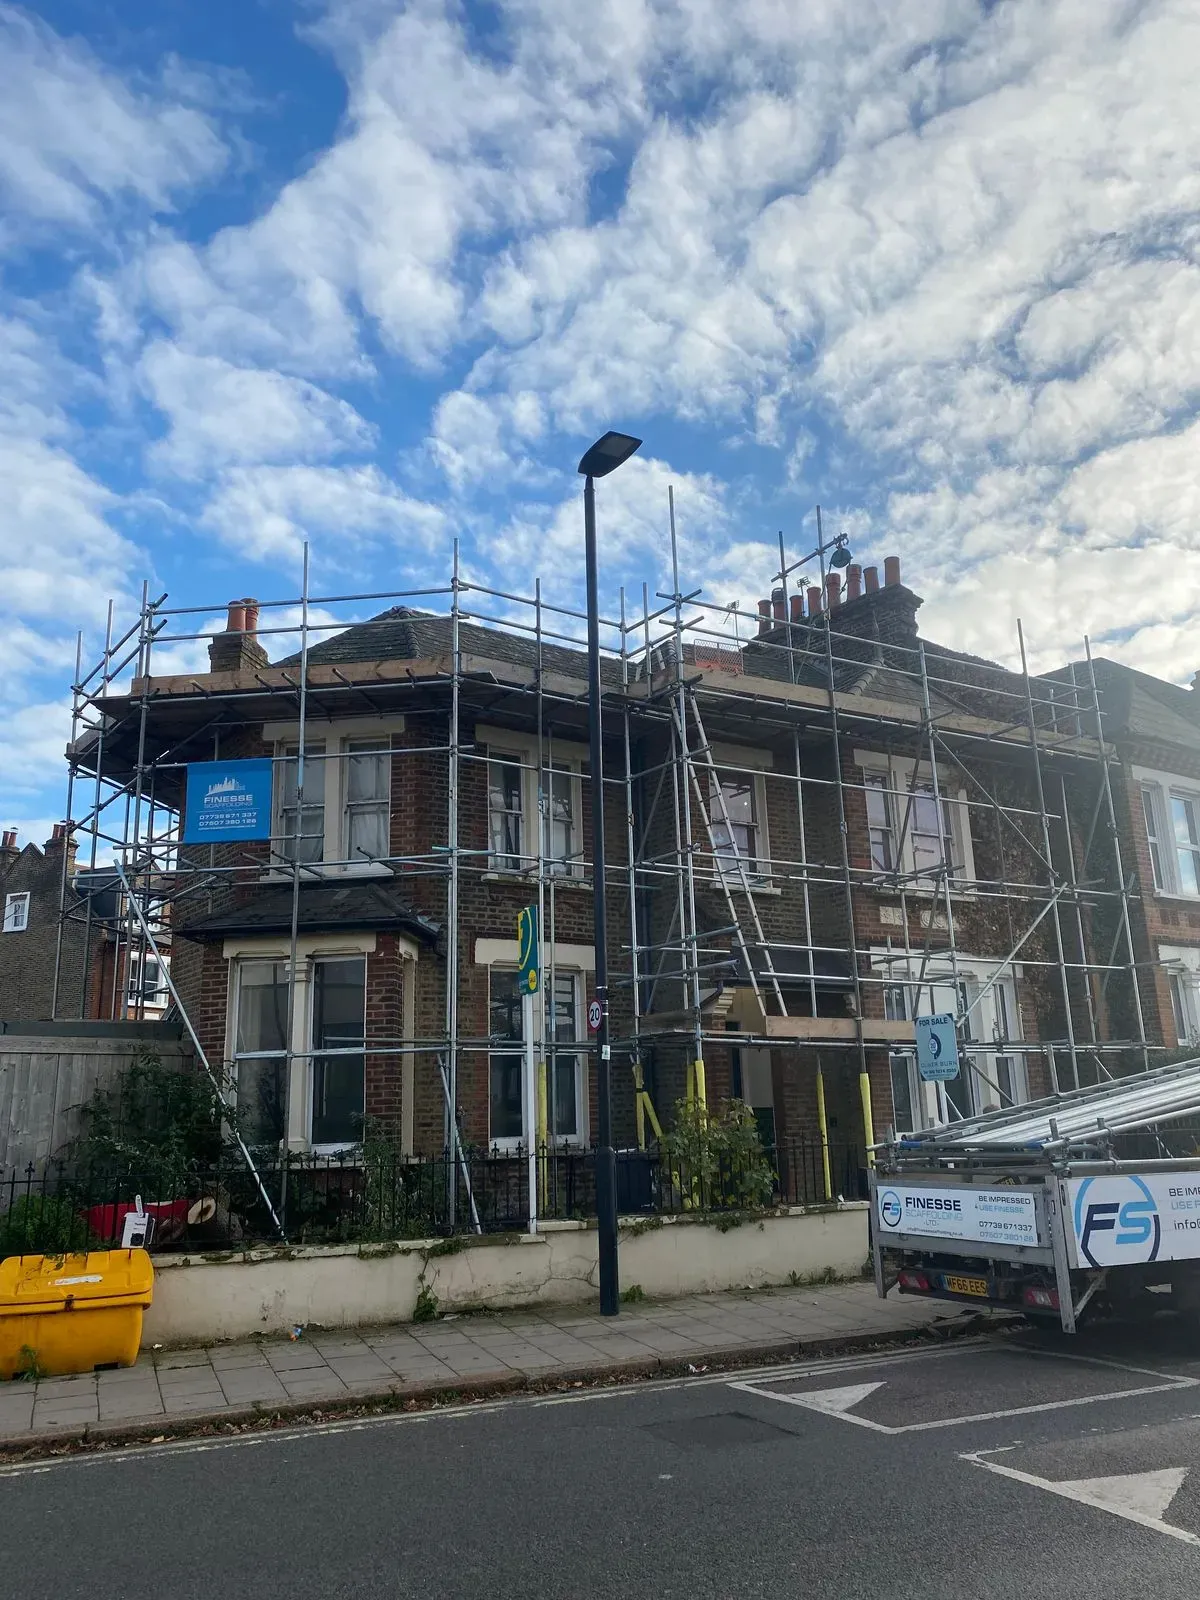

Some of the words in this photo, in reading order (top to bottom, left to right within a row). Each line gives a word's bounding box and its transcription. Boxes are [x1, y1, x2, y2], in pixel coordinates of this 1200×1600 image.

[204, 795, 253, 803] FINESSE
[590, 1007, 600, 1021] 20
[931, 1017, 948, 1025] SALE
[1168, 1187, 1184, 1197] BE
[905, 1196, 962, 1212] FINESSE
[978, 1195, 988, 1203] BE
[989, 1196, 1031, 1205] IMPRESSED
[1171, 1200, 1193, 1210] USE
[979, 1204, 993, 1212] USE
[993, 1205, 1025, 1214] FINESSE
[905, 1208, 964, 1221] SCAFFOLDING
[978, 1220, 1003, 1229] 07739
[1080, 1198, 1158, 1256] FS
[969, 1280, 987, 1294] EES
